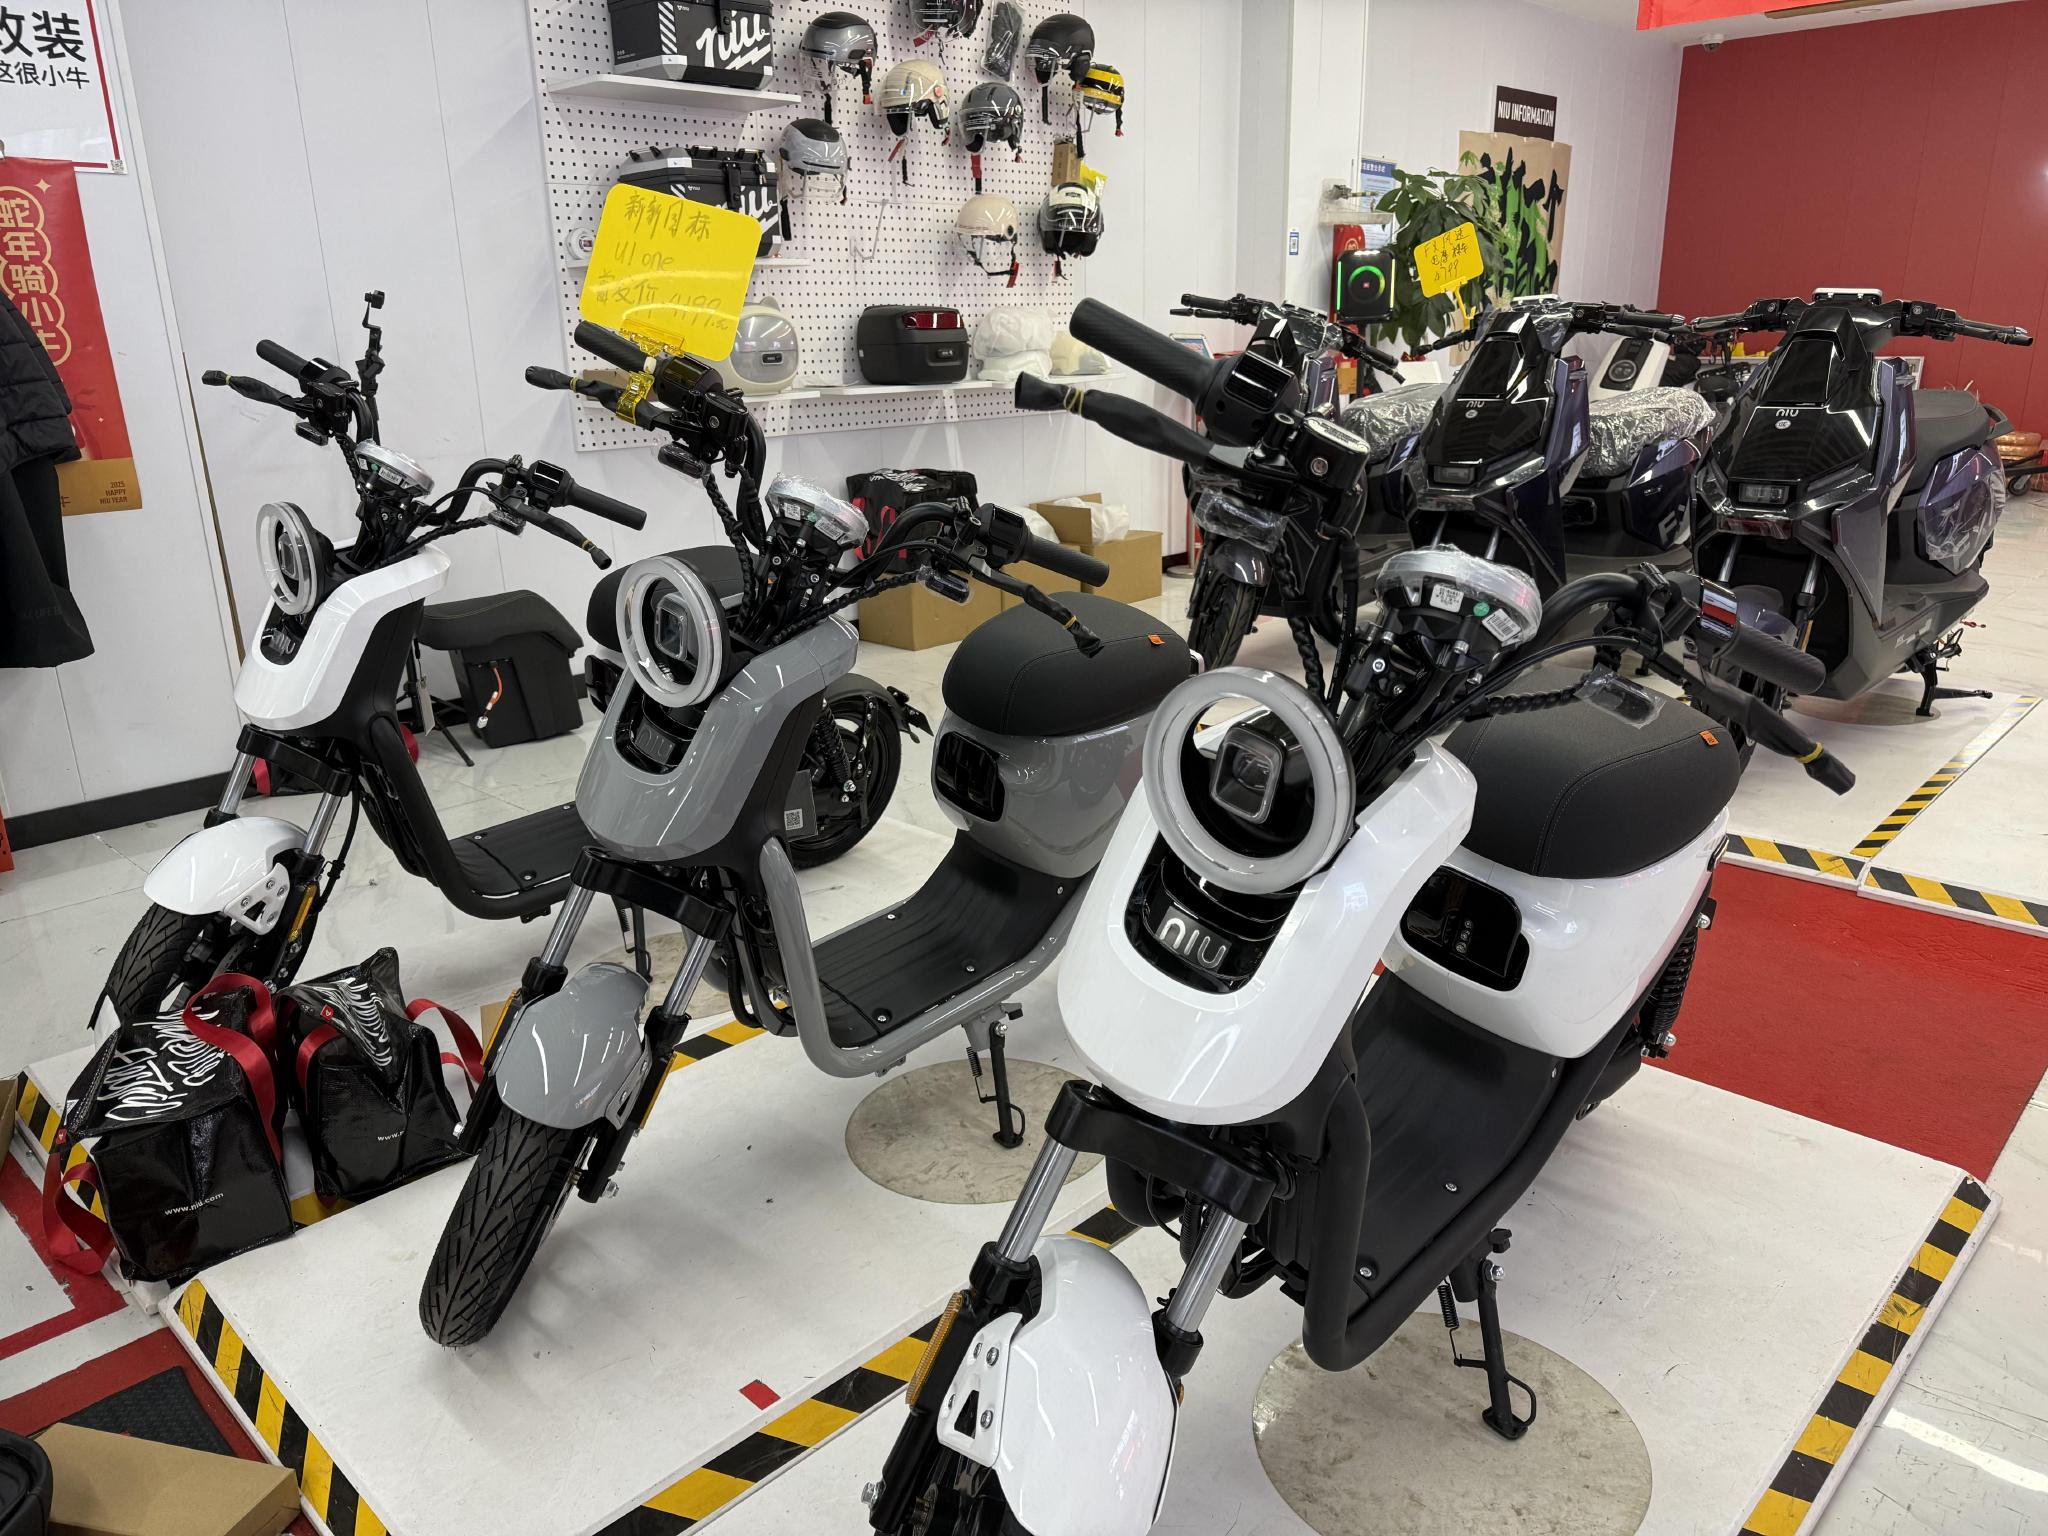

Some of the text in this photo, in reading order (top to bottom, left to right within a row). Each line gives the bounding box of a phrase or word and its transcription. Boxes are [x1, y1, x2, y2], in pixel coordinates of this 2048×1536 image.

[0, 59, 90, 90] 这很小牛
[1497, 100, 1555, 128] NIU INFORMATION
[642, 250, 675, 273] one
[105, 489, 126, 497] HAPPY
[111, 496, 128, 504] YEAR
[164, 1192, 225, 1216] www.niu.com
